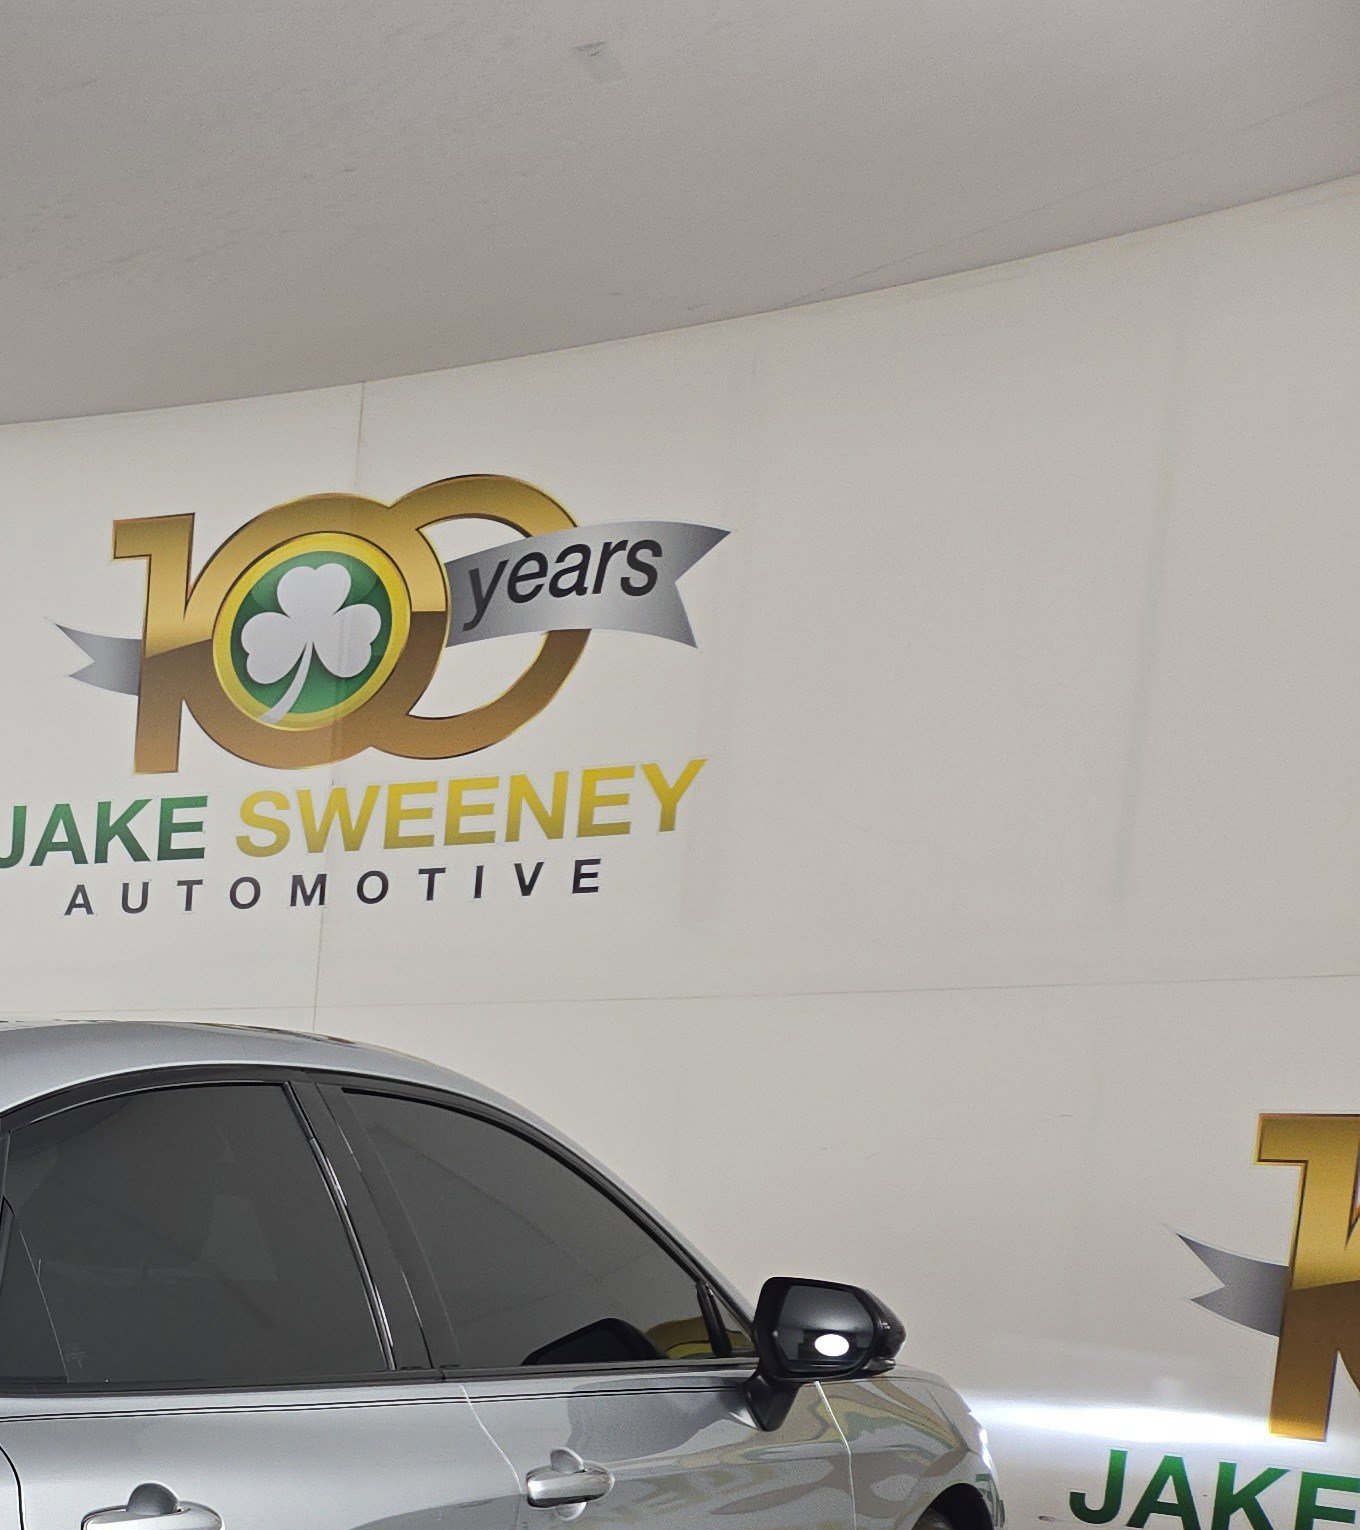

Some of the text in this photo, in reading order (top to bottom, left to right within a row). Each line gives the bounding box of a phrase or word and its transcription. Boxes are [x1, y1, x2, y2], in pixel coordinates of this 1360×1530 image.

[462, 532, 664, 630] years
[234, 758, 708, 858] SWEENEY
[64, 857, 602, 917] AUTOMOTIVE
